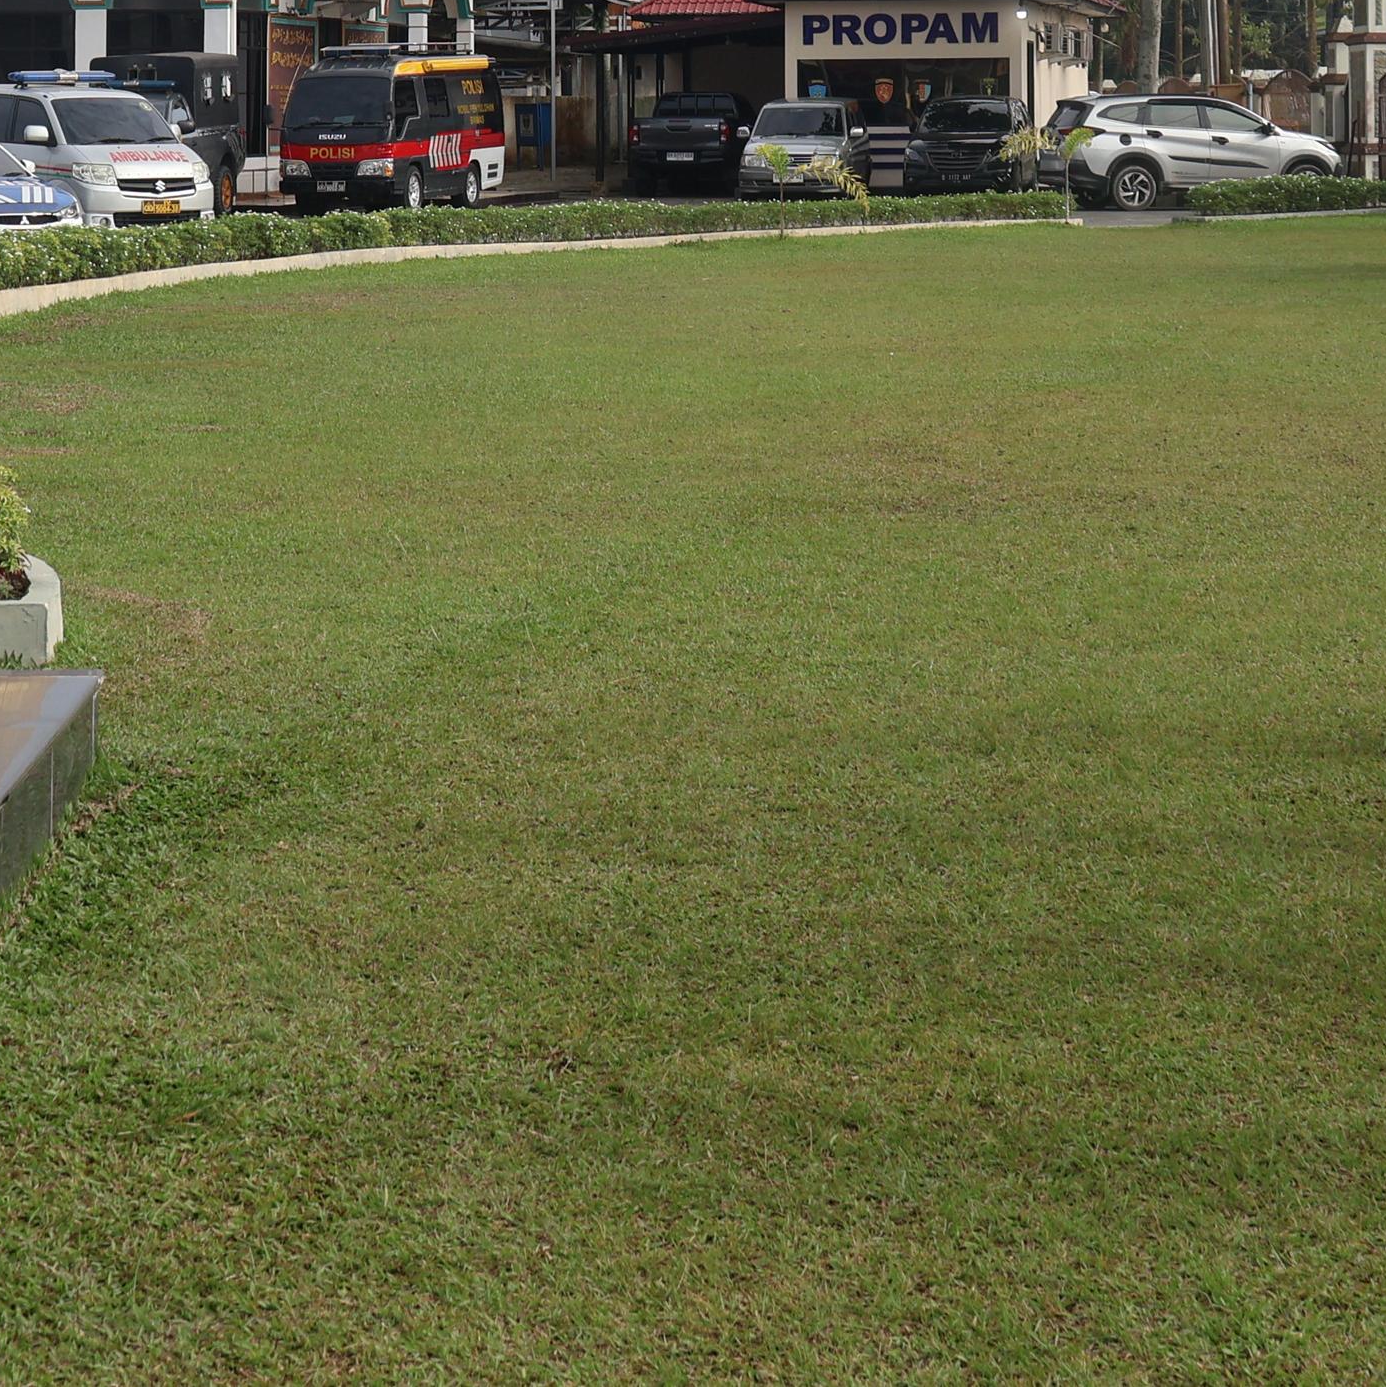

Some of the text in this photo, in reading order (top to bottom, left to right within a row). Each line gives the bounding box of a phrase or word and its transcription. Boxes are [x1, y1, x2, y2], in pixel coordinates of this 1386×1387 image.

[802, 11, 999, 46] PROPAM
[461, 79, 485, 95] POLISI
[109, 150, 190, 164] AMBULANCE
[310, 147, 355, 159] POLISI
